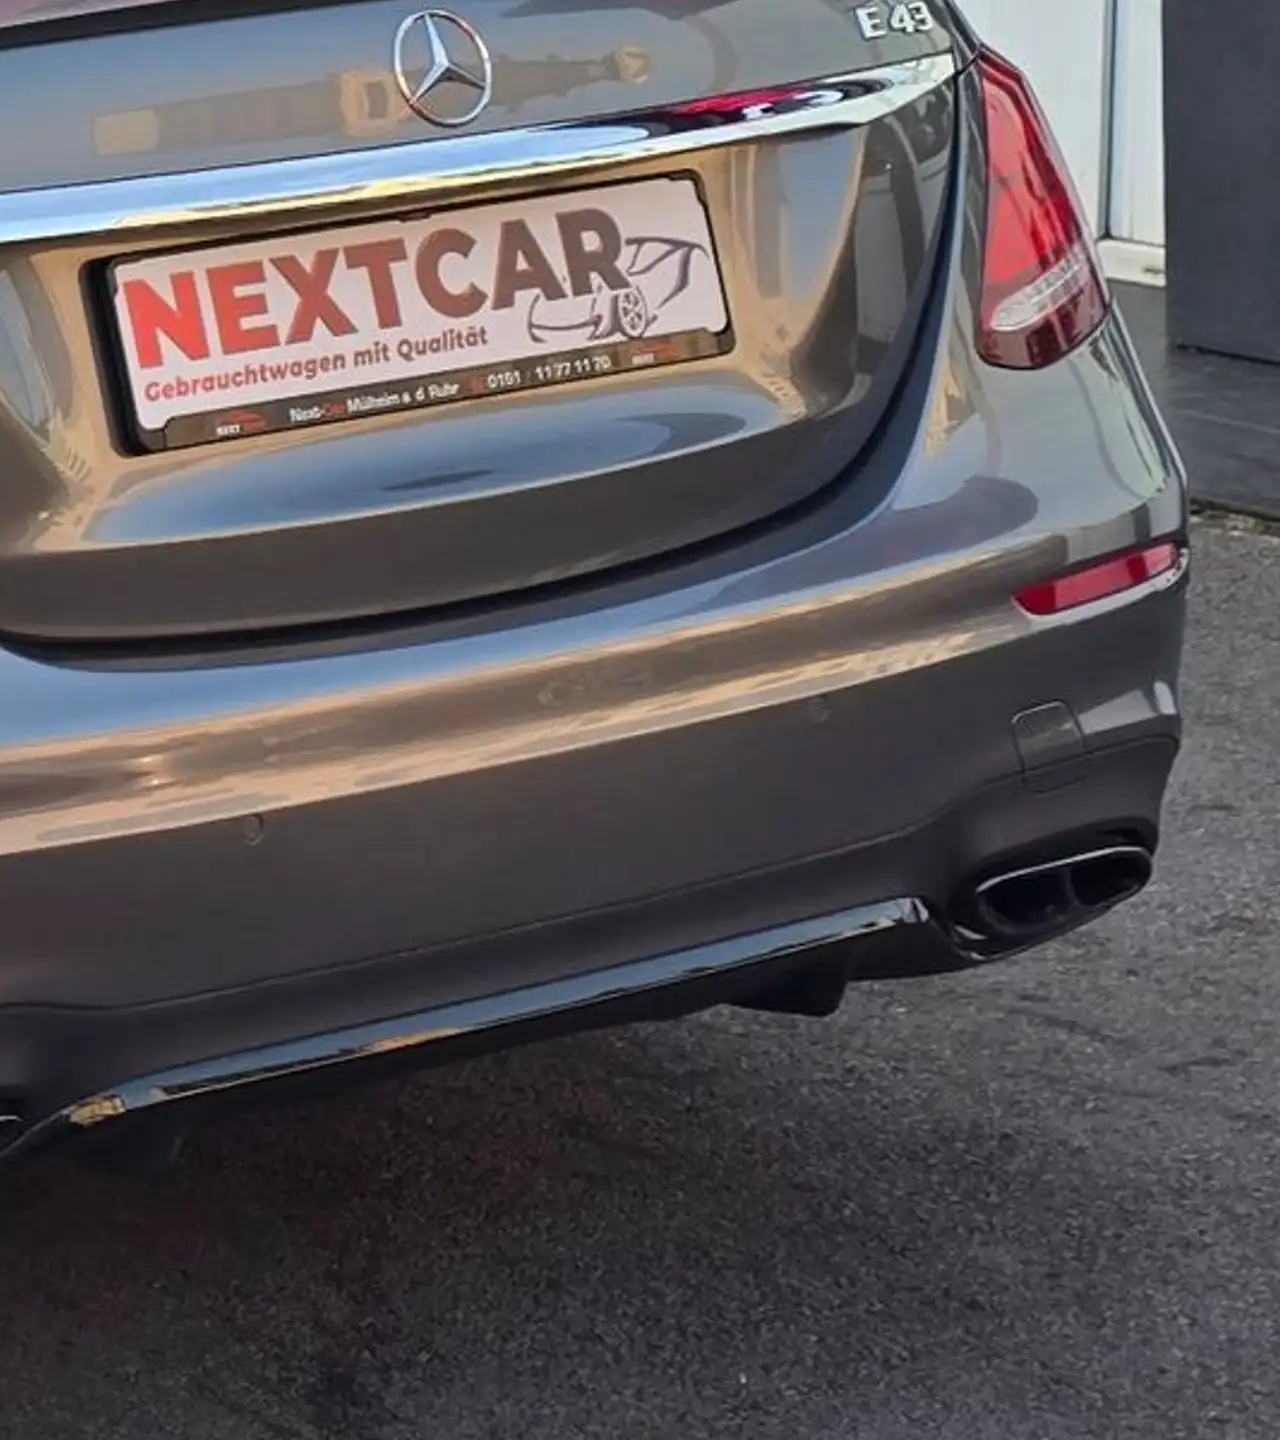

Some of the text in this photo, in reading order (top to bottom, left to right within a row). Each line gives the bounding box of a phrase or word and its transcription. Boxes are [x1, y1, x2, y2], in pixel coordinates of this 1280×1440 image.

[122, 208, 630, 368] NEXTCAR
[143, 326, 488, 403] Gebrauchtwagen mit Qualität
